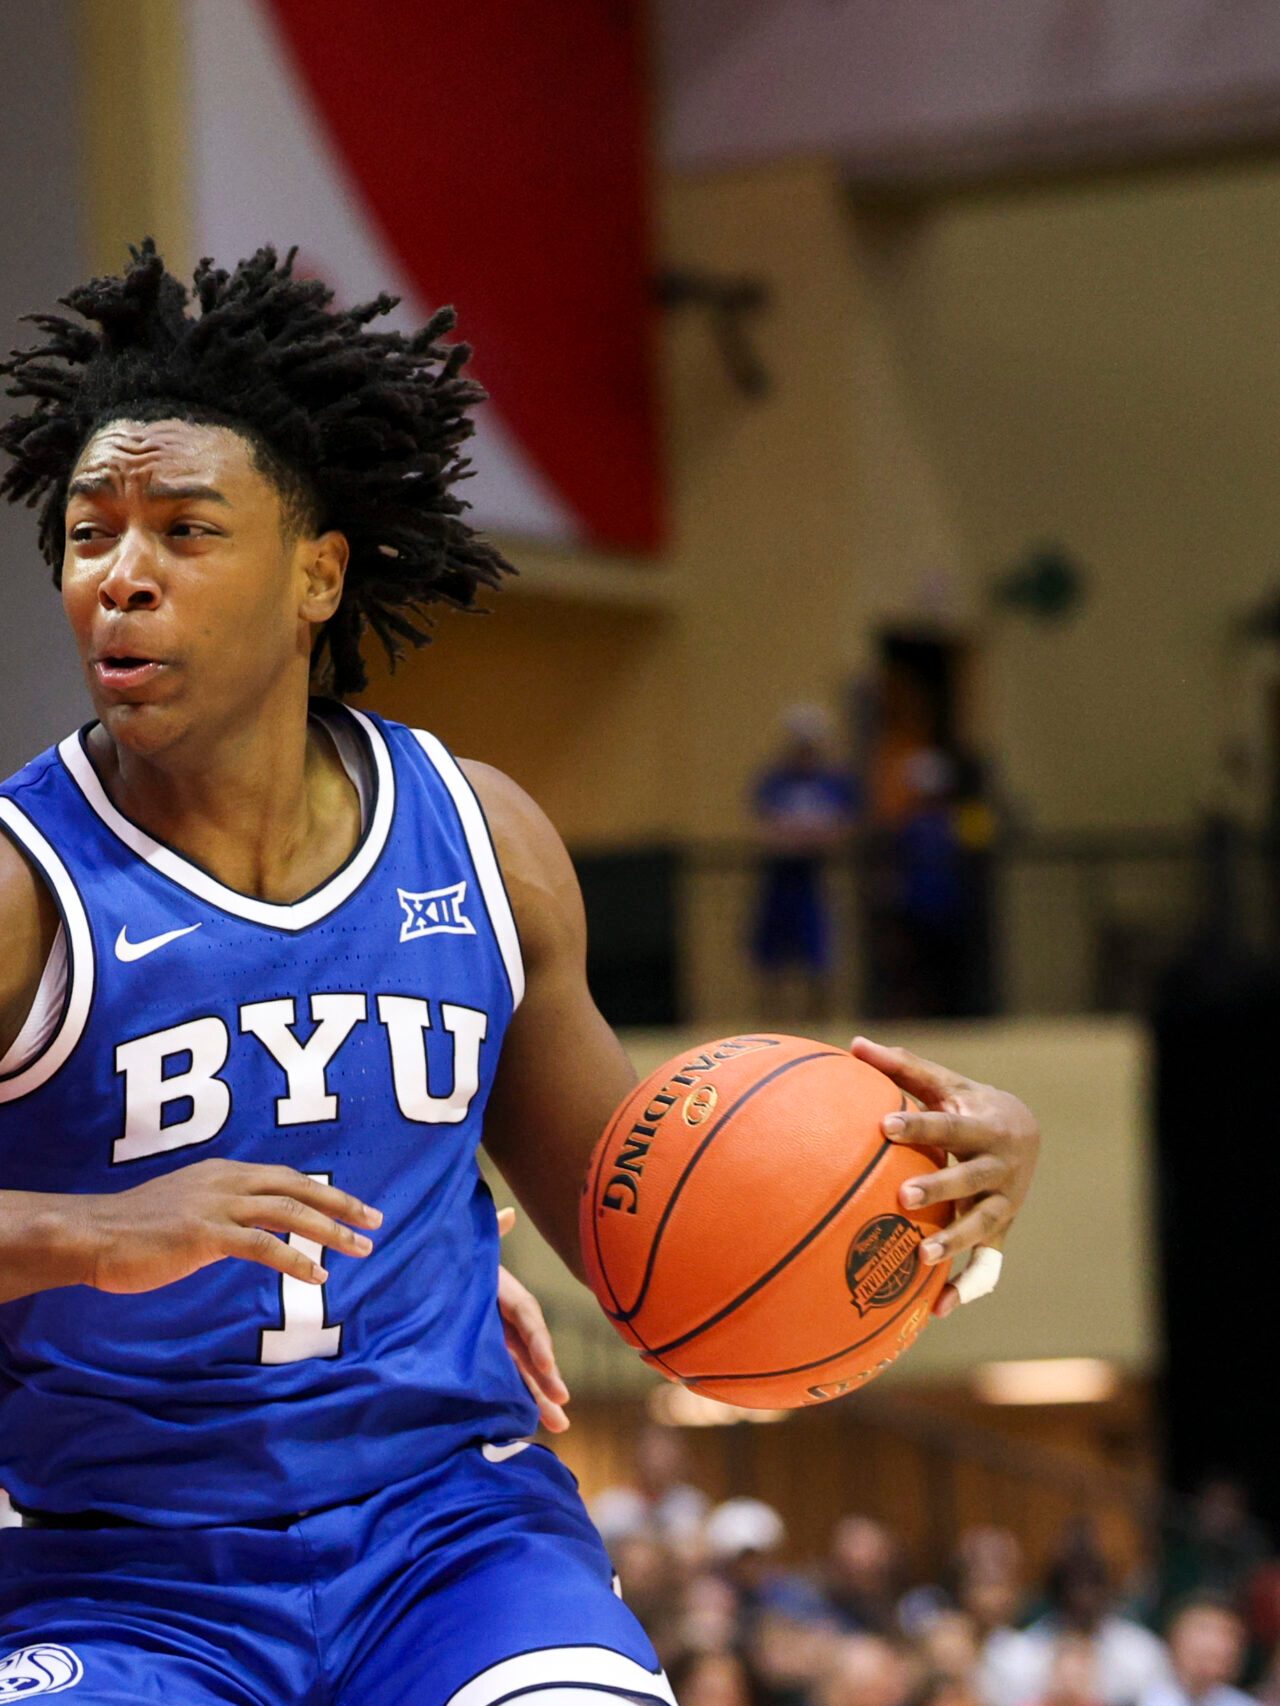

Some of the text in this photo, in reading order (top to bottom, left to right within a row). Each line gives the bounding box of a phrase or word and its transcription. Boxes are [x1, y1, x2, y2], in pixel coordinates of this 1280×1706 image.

[402, 890, 468, 935] XII
[111, 993, 488, 1165] BYU
[257, 1173, 344, 1365] 1
[858, 1233, 916, 1301] INVITATIONAL
